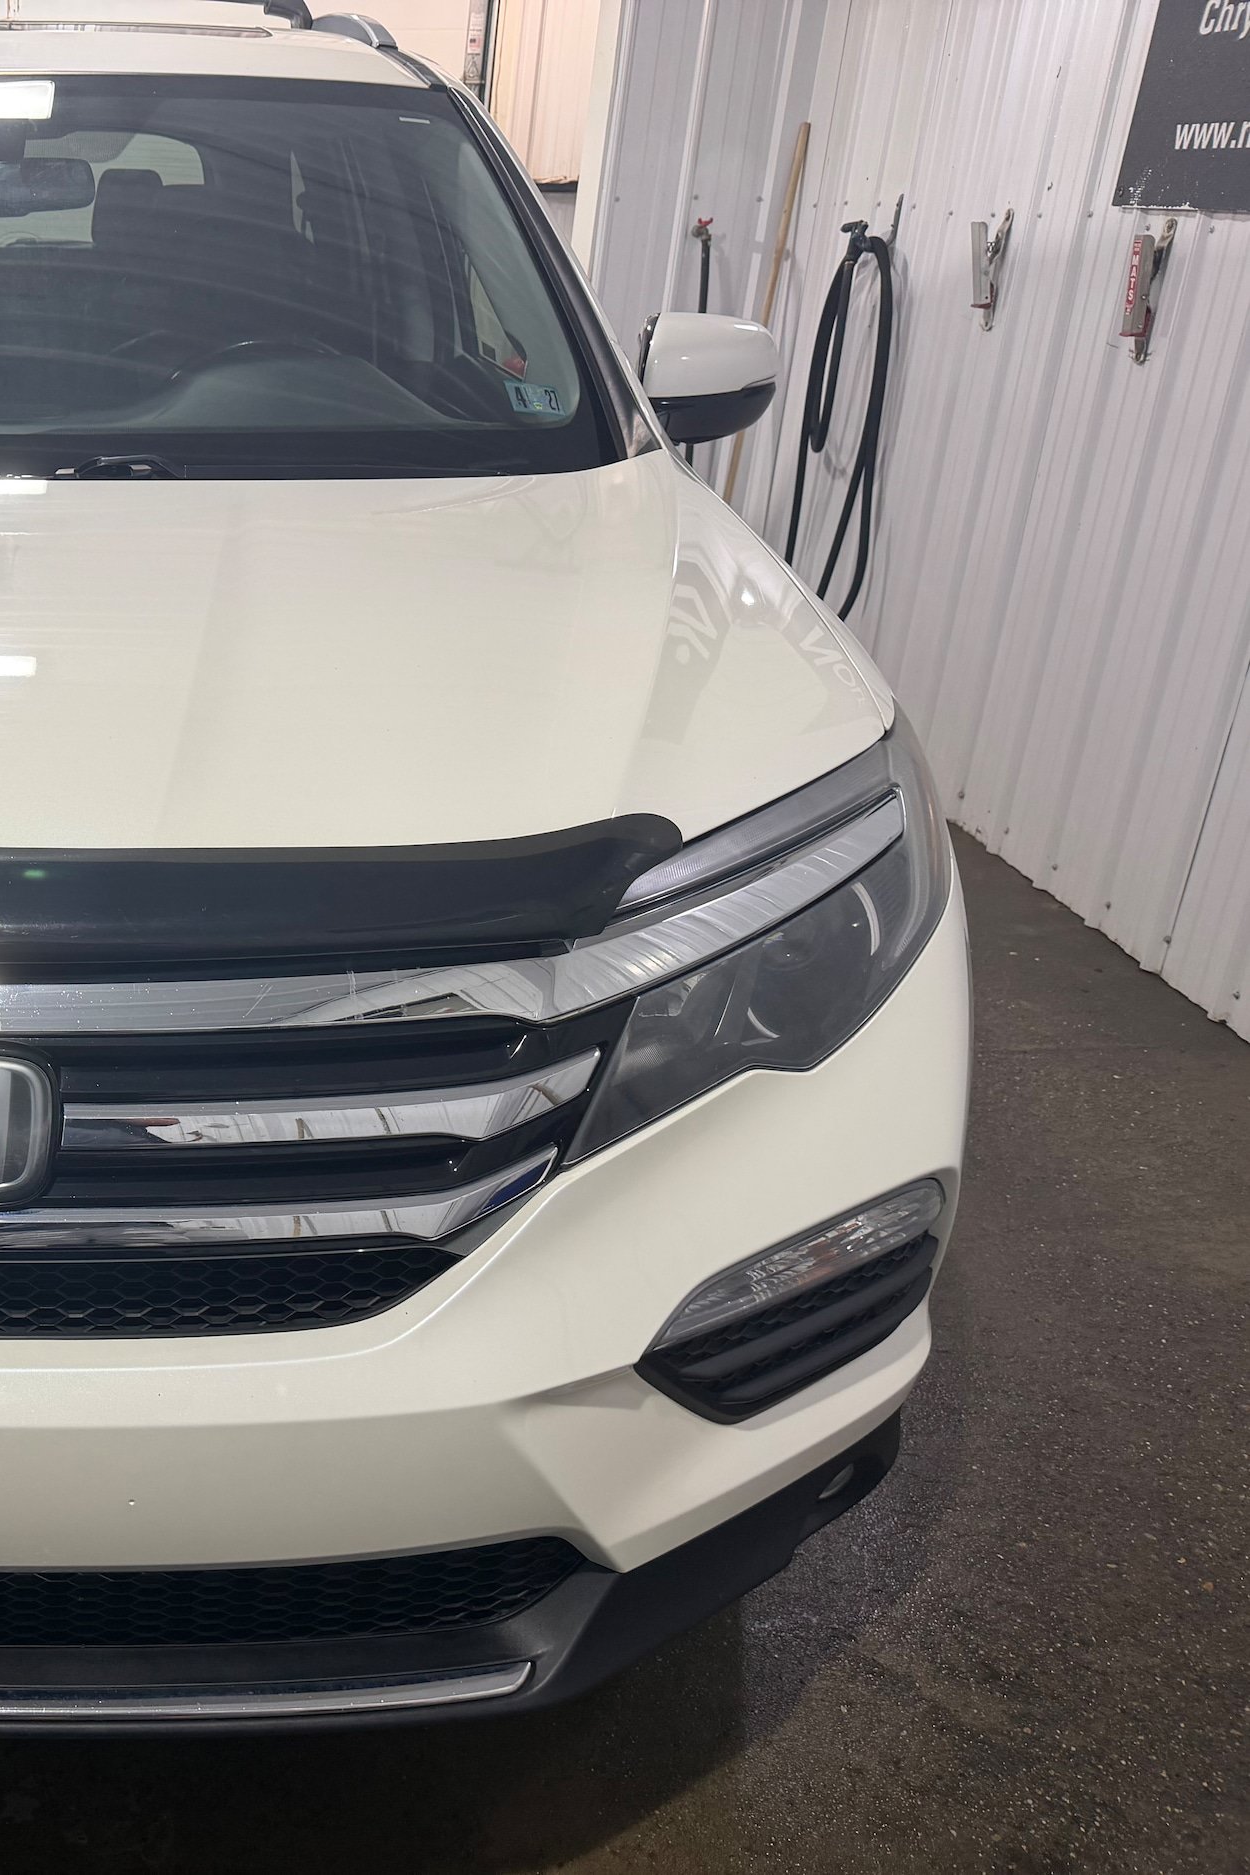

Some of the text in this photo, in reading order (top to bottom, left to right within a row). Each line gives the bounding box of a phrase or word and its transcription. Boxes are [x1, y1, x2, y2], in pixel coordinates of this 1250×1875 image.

[1127, 254, 1140, 301] MATS
[514, 386, 560, 411] 4 27
